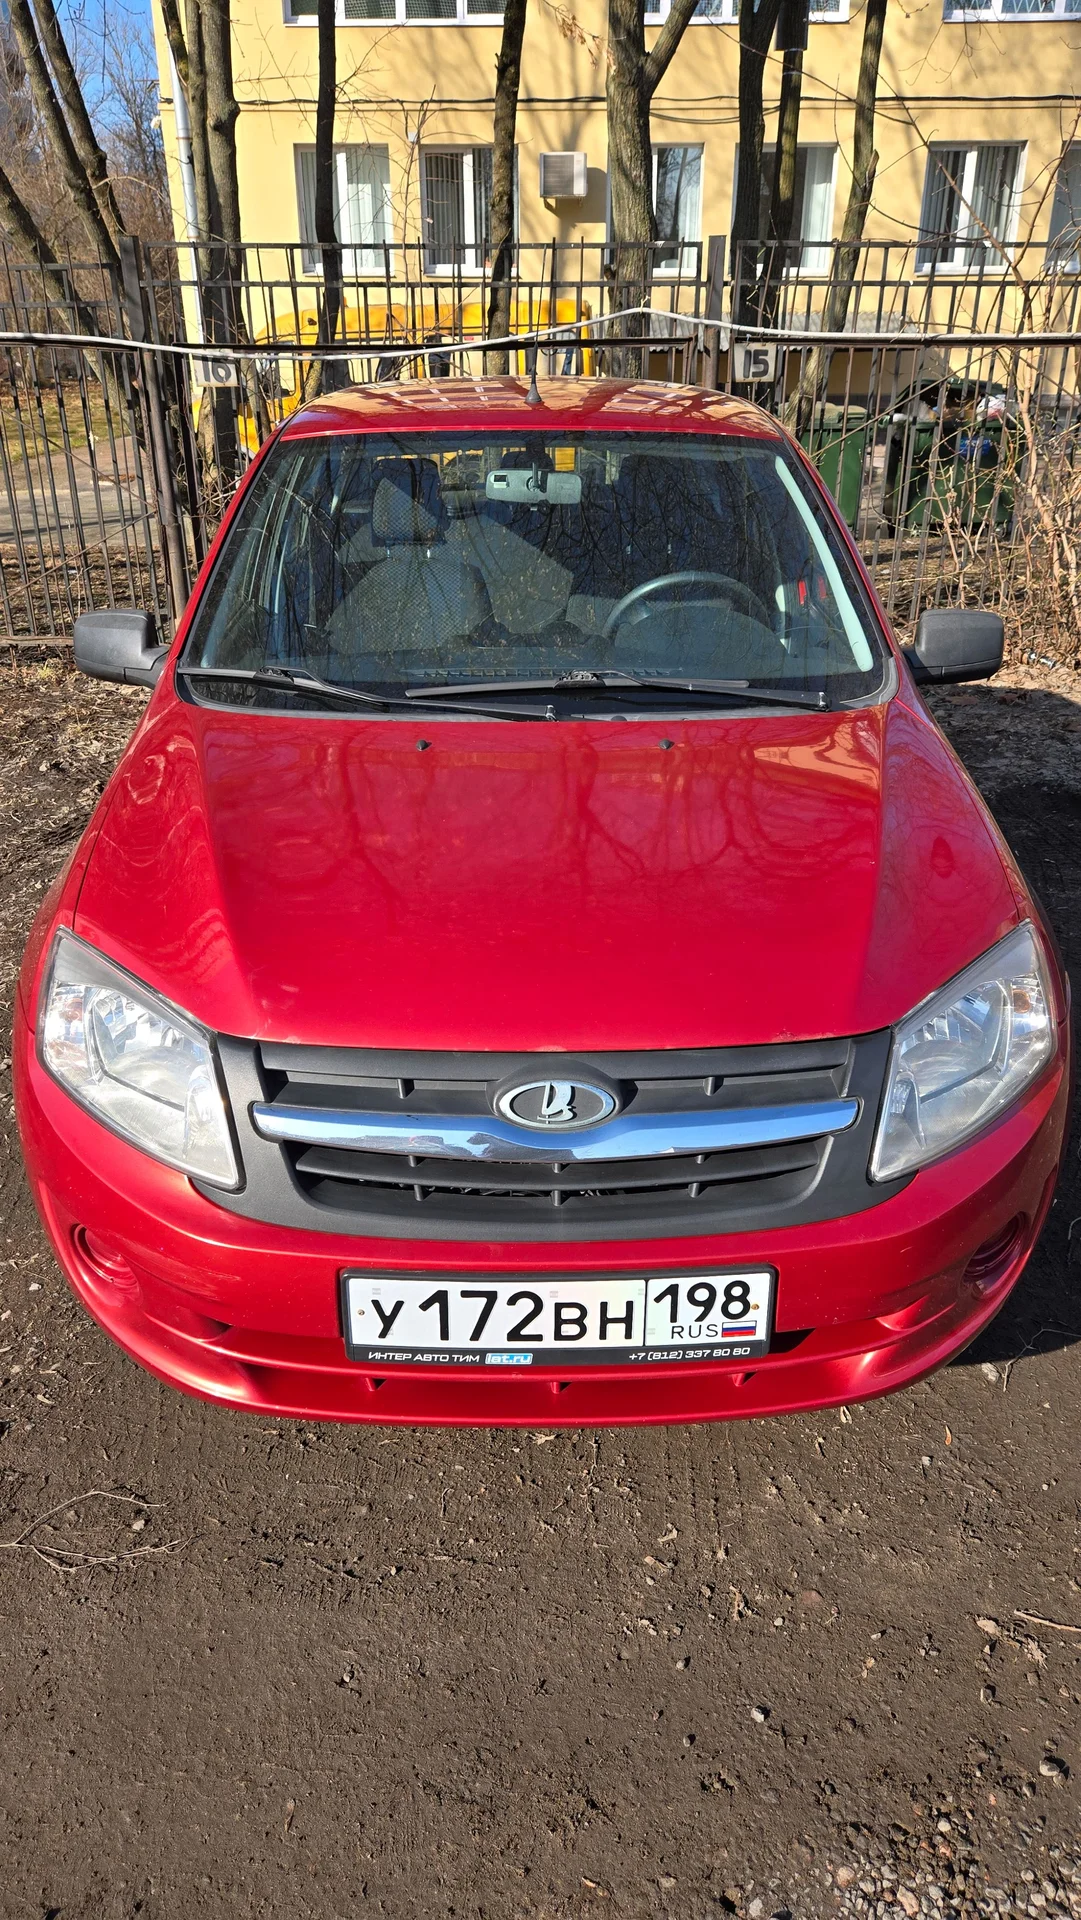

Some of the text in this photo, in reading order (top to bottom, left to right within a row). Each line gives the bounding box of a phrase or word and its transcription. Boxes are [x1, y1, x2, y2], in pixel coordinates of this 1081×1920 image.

[743, 349, 769, 379] 15
[653, 1280, 751, 1323] 198
[671, 1324, 719, 1340] RUS
[368, 1351, 412, 1362] ИНТЕР
[413, 1353, 449, 1362] АВТО
[452, 1354, 480, 1363] ТИМ
[629, 1347, 750, 1361] +7 (812) 337 80 80
